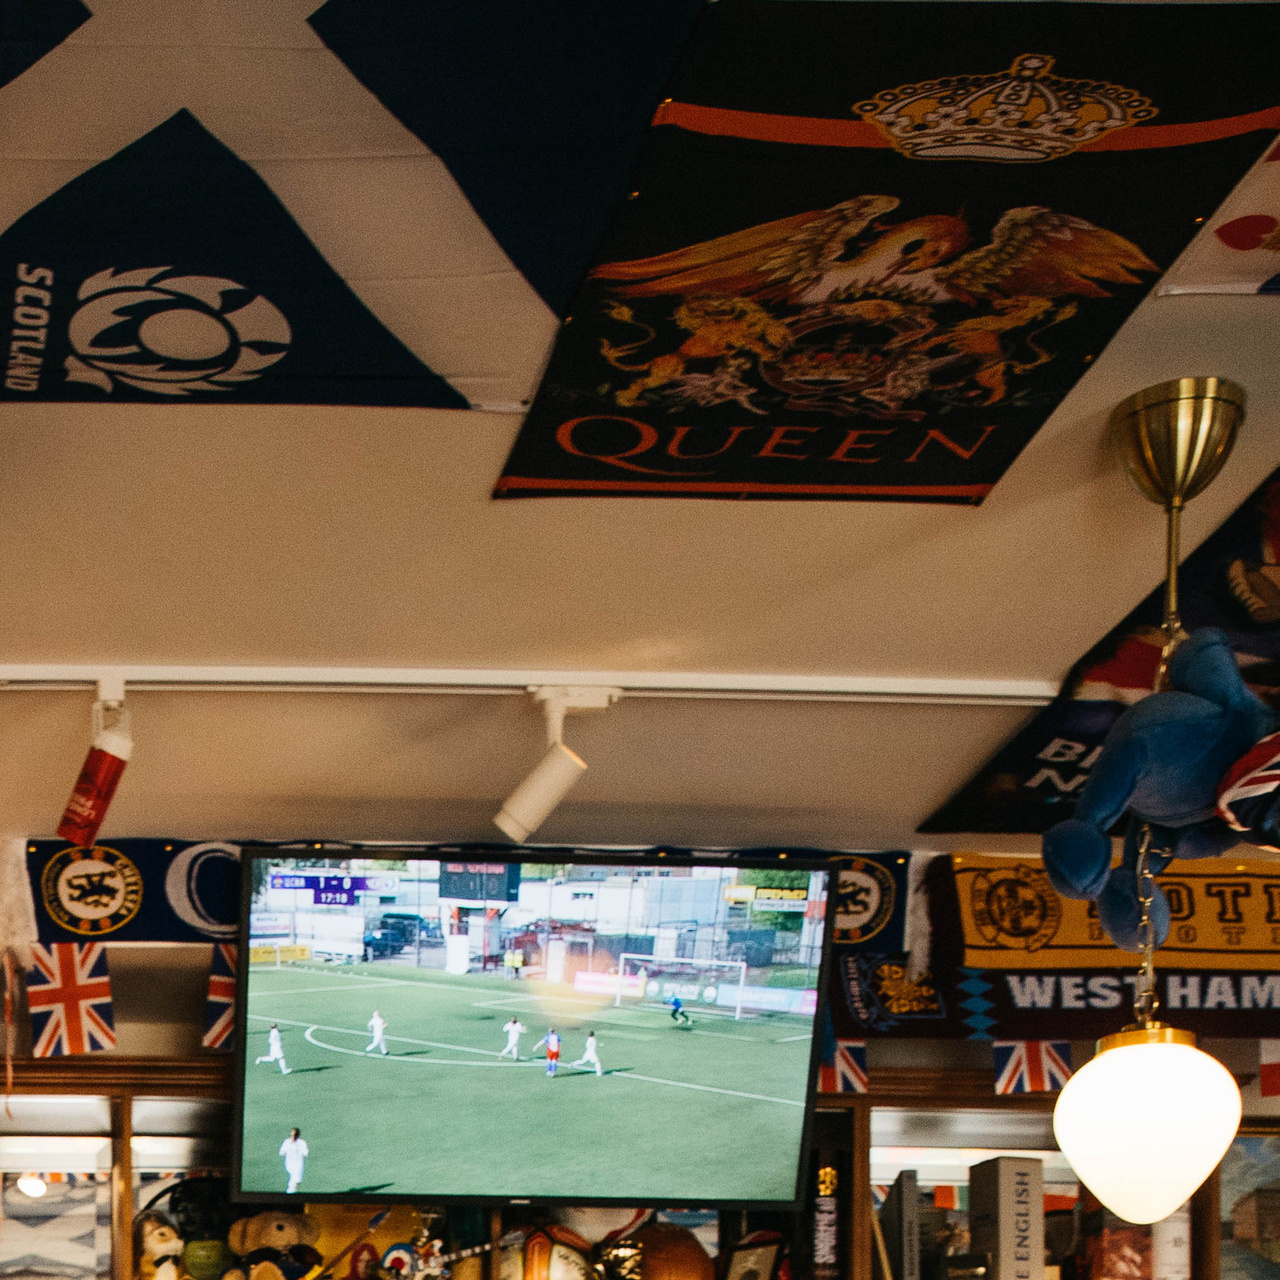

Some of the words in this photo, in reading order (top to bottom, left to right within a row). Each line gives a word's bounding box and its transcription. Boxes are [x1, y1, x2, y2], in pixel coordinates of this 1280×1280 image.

[4, 263, 55, 392] SCOTLAND
[555, 414, 998, 477] QUEEN
[1006, 974, 1150, 1009] WEST
[1166, 974, 1280, 1010] HAM
[1014, 1170, 1031, 1262] ENGLISH
